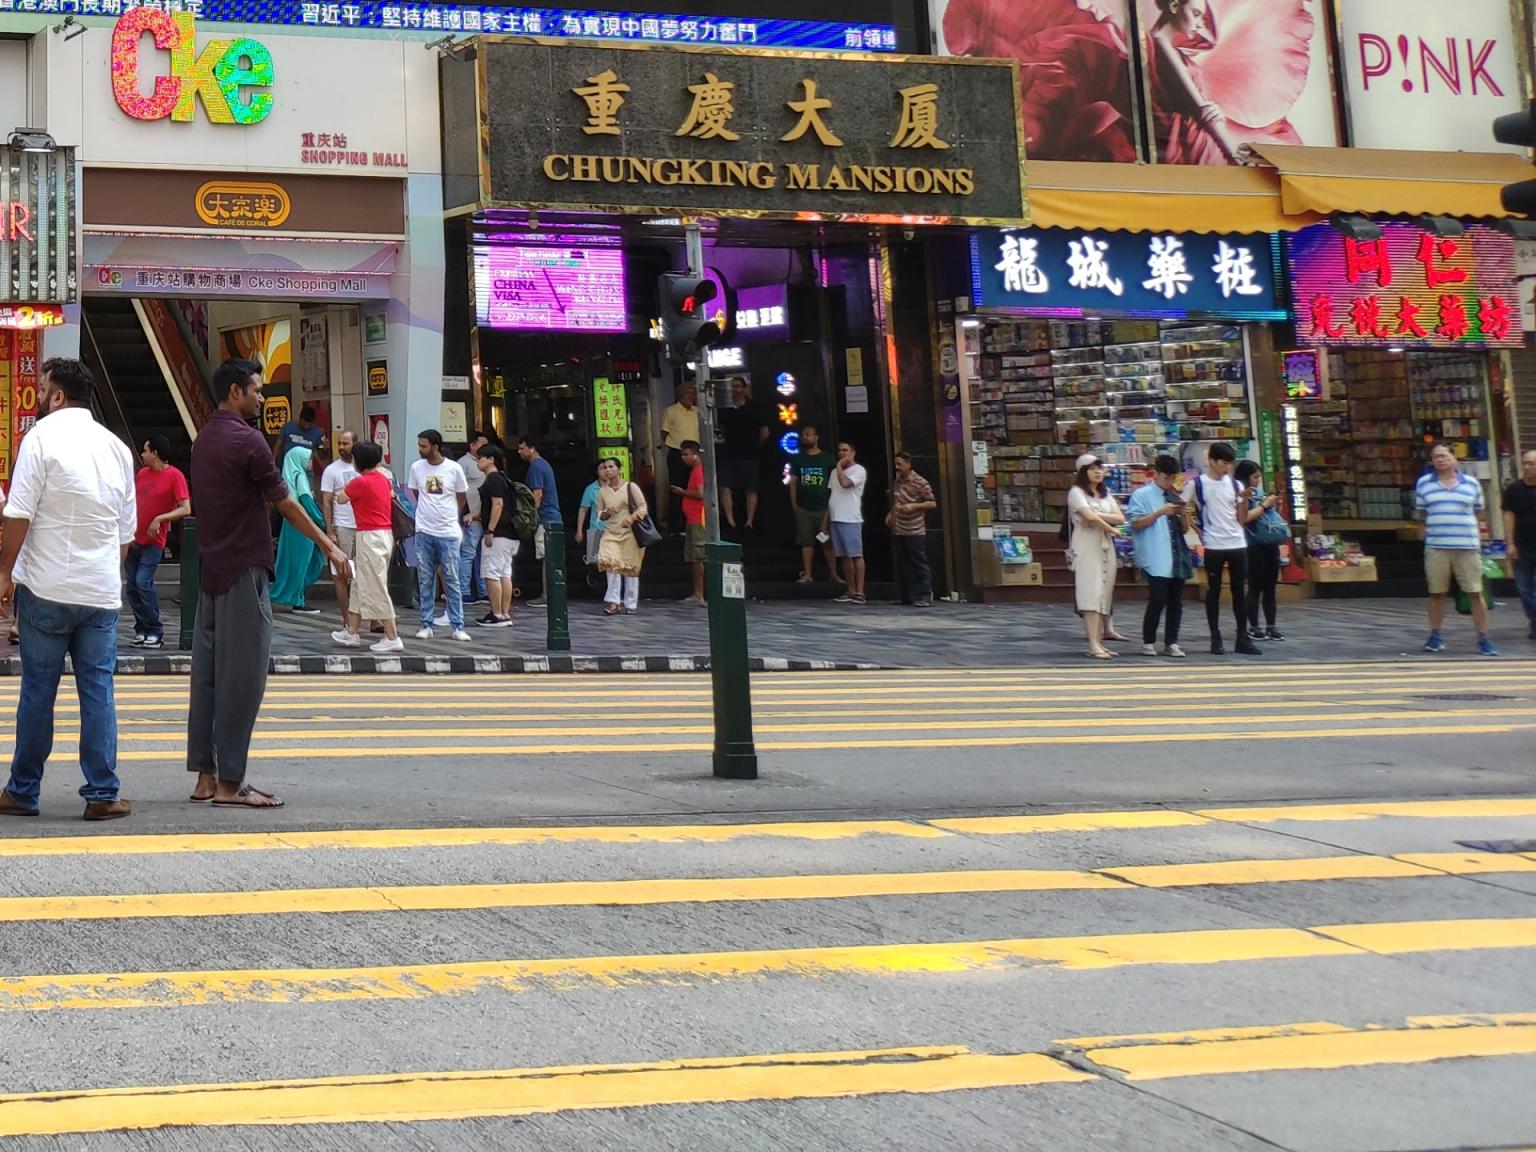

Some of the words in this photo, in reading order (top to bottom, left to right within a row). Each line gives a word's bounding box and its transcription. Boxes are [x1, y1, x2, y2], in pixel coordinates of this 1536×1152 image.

[111, 6, 274, 125] Cke
[1358, 32, 1505, 97] P!NK
[301, 150, 368, 166] SHOPPING
[372, 152, 408, 167] MALL
[543, 153, 776, 190] CHUNGKING
[785, 162, 975, 196] MANSIONS
[248, 275, 273, 289] Cke
[277, 277, 337, 293] Shopping
[341, 279, 366, 291] Mall
[494, 280, 536, 290] CHINA
[494, 291, 522, 301] VISA
